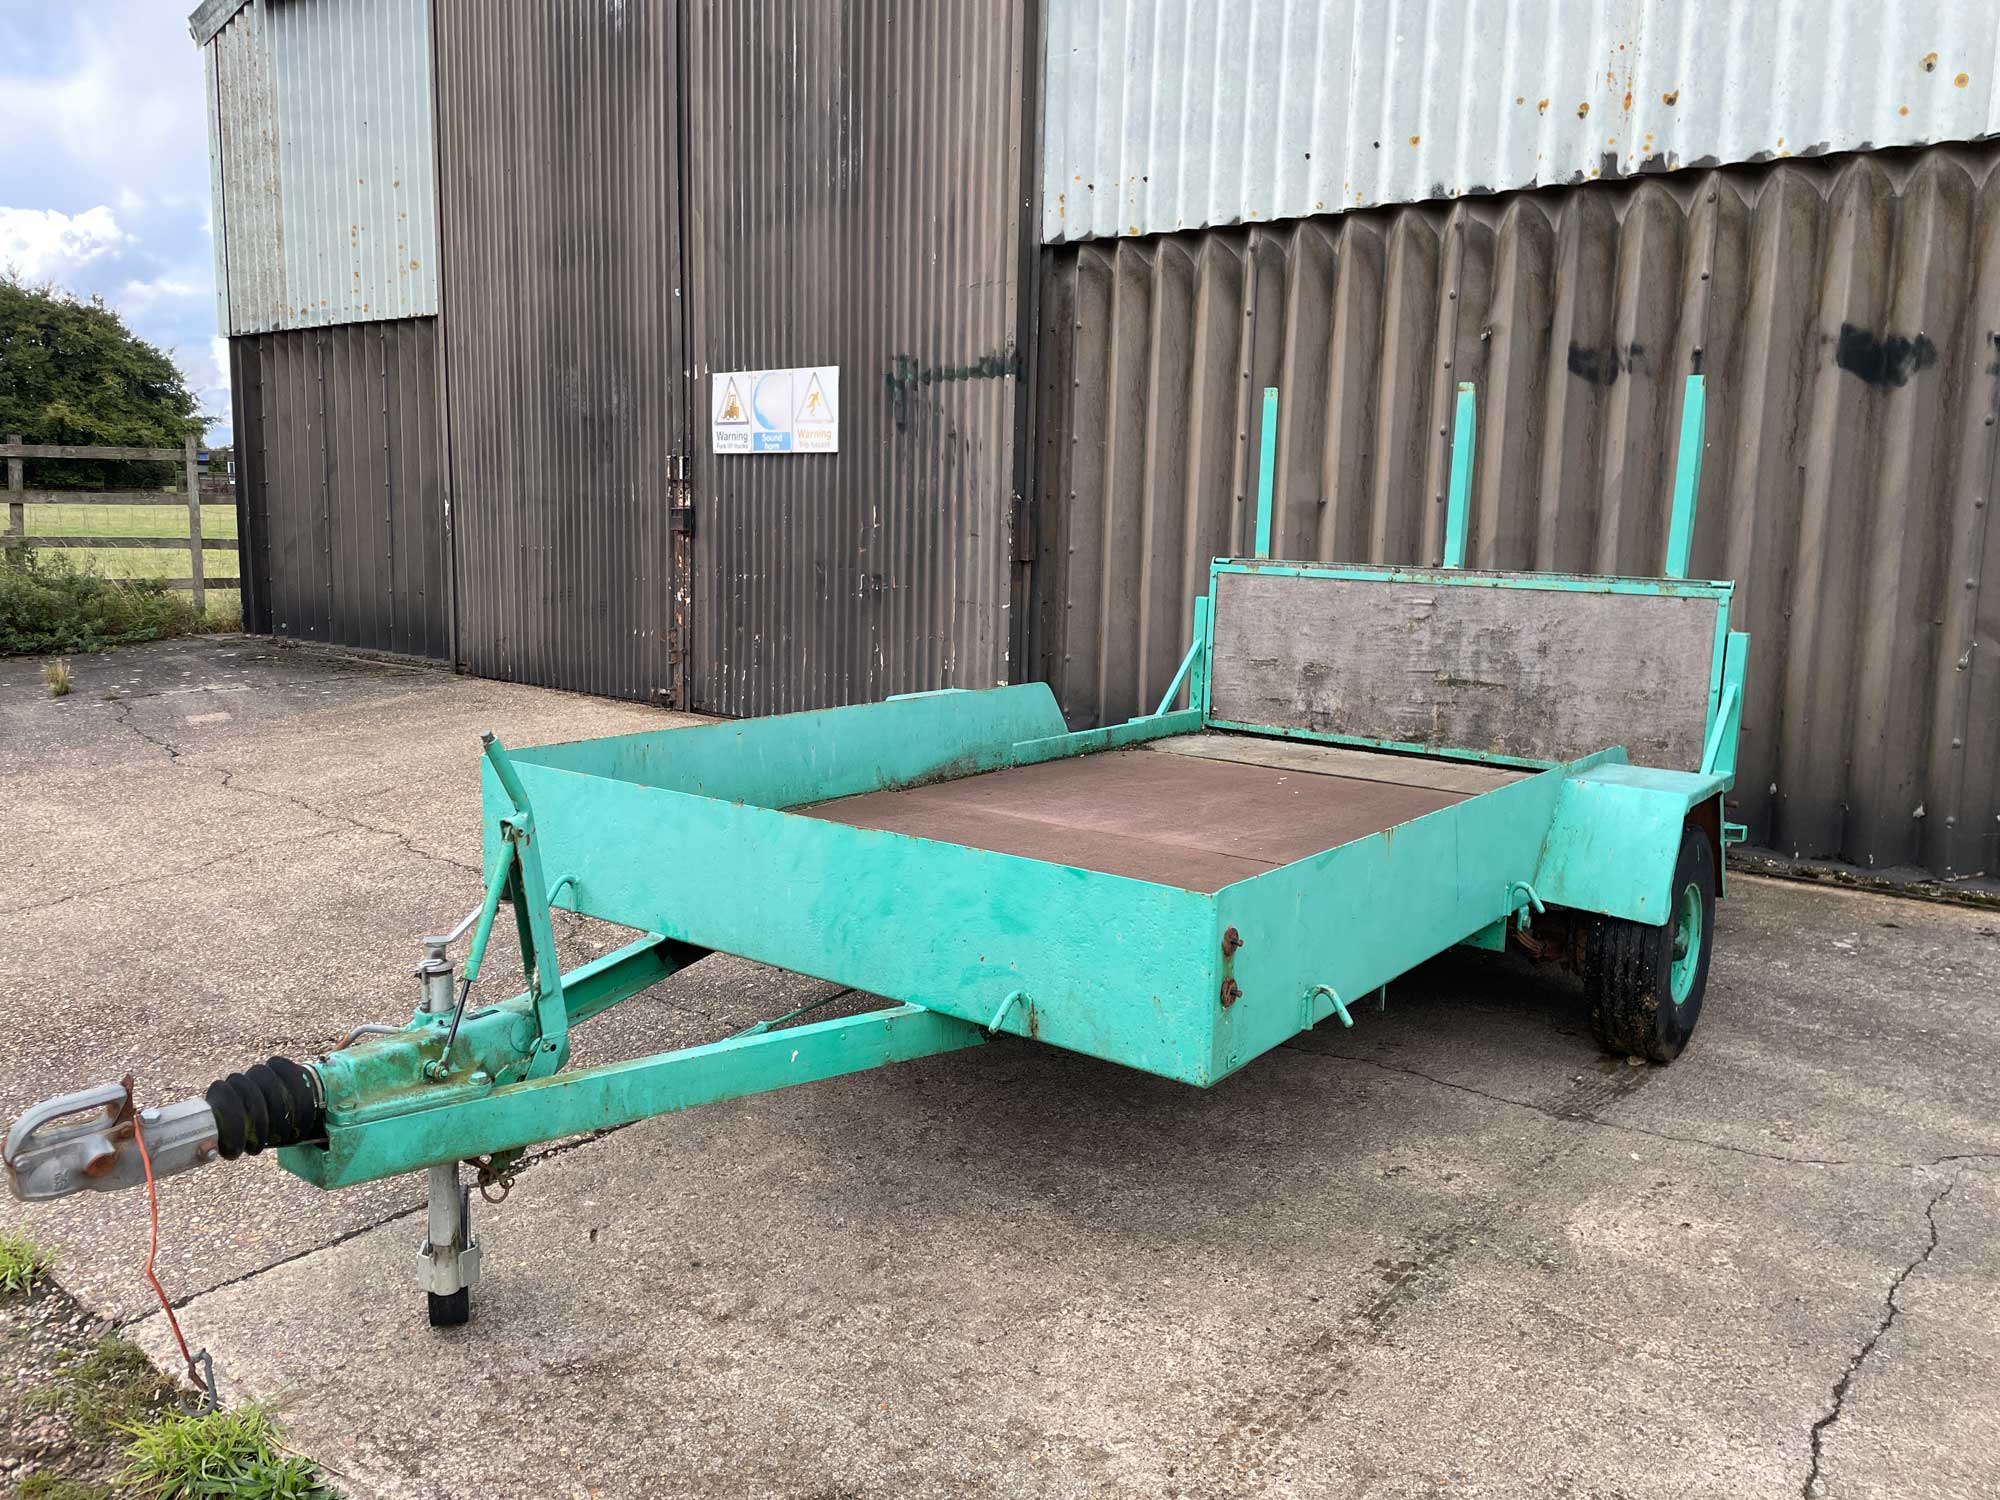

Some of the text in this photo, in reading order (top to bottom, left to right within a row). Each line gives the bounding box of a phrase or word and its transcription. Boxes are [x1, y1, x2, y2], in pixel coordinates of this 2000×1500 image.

[716, 432, 748, 443] Warning
[761, 433, 783, 442] Sound
[797, 429, 831, 440] Warning
